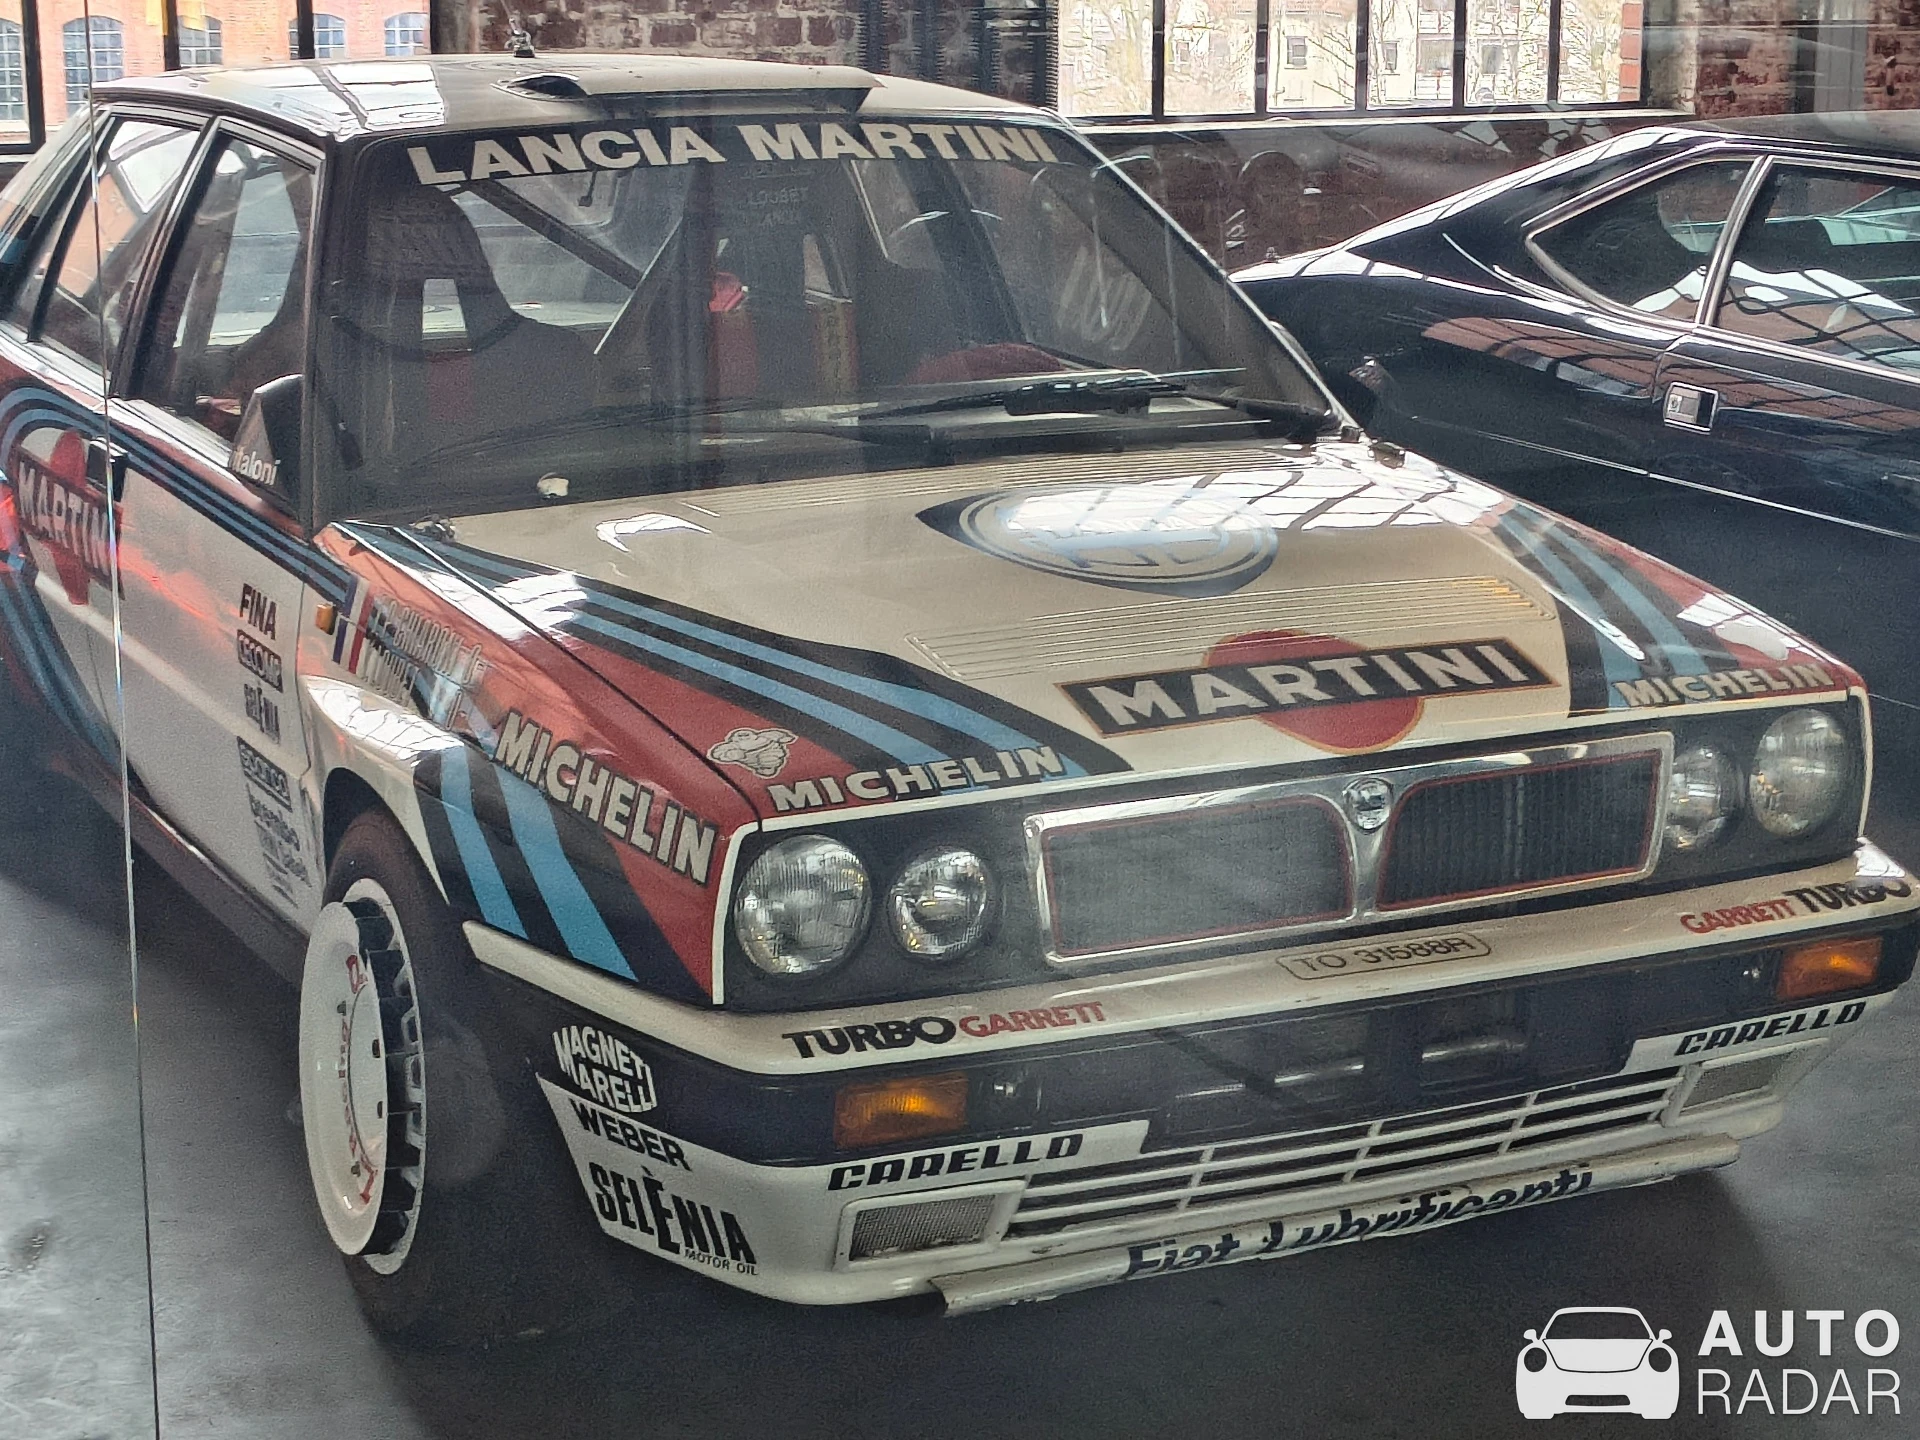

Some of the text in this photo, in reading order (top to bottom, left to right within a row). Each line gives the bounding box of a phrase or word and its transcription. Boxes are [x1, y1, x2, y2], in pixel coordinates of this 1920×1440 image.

[408, 122, 1061, 187] LANCIA MARTINI
[239, 582, 277, 641] FINA
[1088, 644, 1530, 726] MARTINI
[1614, 662, 1835, 707] MICHELIN
[494, 710, 718, 886] MICHELIN
[768, 746, 1066, 812] MICHELIN
[1680, 878, 1912, 934] GARRETT TURBO
[1294, 953, 1347, 972] TO
[782, 1001, 1108, 1059] TURBO GARRETT
[1674, 1000, 1867, 1056] CARELLO
[569, 1097, 693, 1172] WEBER
[828, 1133, 1084, 1191] CARELLO
[684, 1248, 758, 1276] MOTOR OIL
[1120, 1233, 1241, 1278] Fiat
